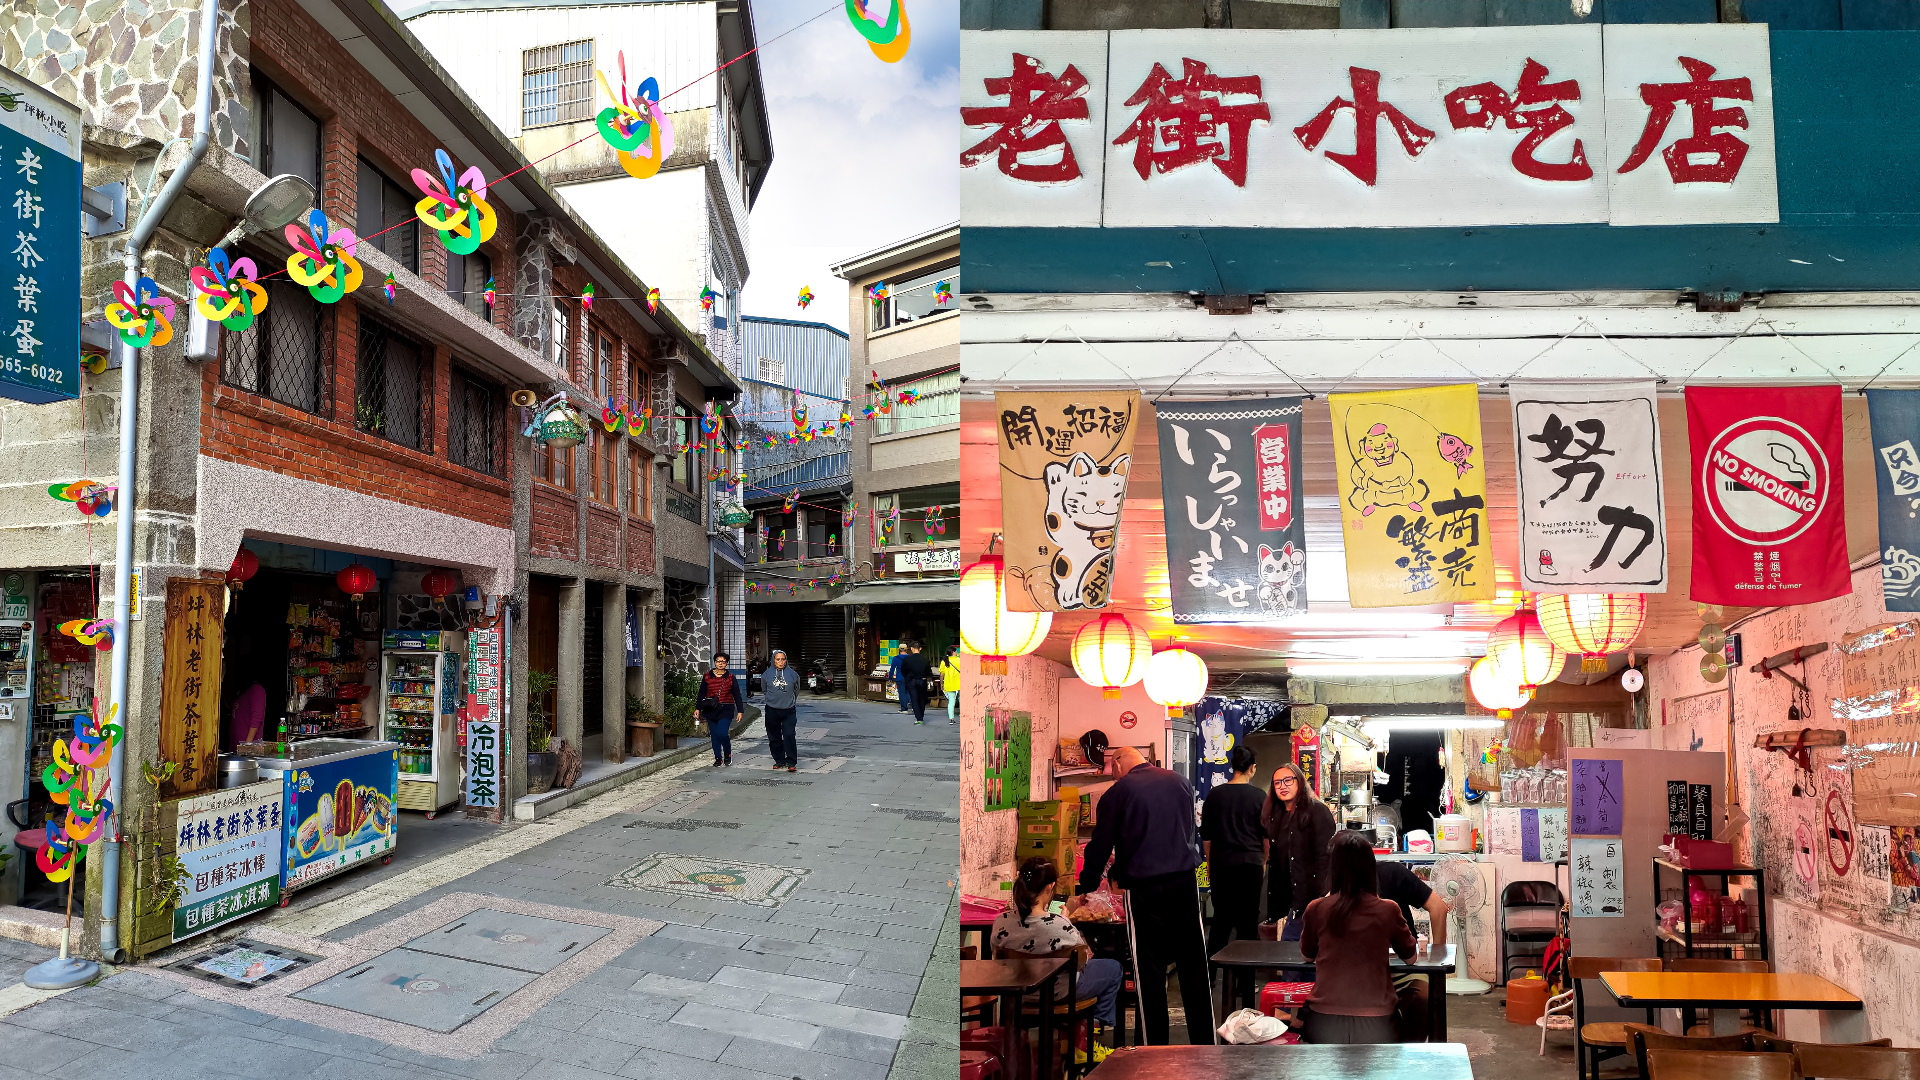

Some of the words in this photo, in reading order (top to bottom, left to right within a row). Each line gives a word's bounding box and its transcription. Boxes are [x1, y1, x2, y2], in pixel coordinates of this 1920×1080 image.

[25, 103, 67, 133] 坪林小吃
[960, 53, 1754, 189] 老街小吃店
[11, 146, 44, 357] 老街茶葉蛋
[1259, 437, 1288, 520] 営業中
[1527, 414, 1654, 573] 努力
[1615, 472, 1648, 480] Effort
[1713, 450, 1739, 473] NO
[1740, 467, 1816, 512] SMOKING
[857, 627, 868, 671] 坪林老街
[178, 595, 206, 783] 坪林老街茶葉蛋
[470, 723, 496, 806] 冷泡茶
[179, 801, 281, 850] 坪林老街茶葉蛋
[195, 853, 266, 893] 包種茶冰棒
[185, 882, 271, 930] 包種茶冰淇淋
